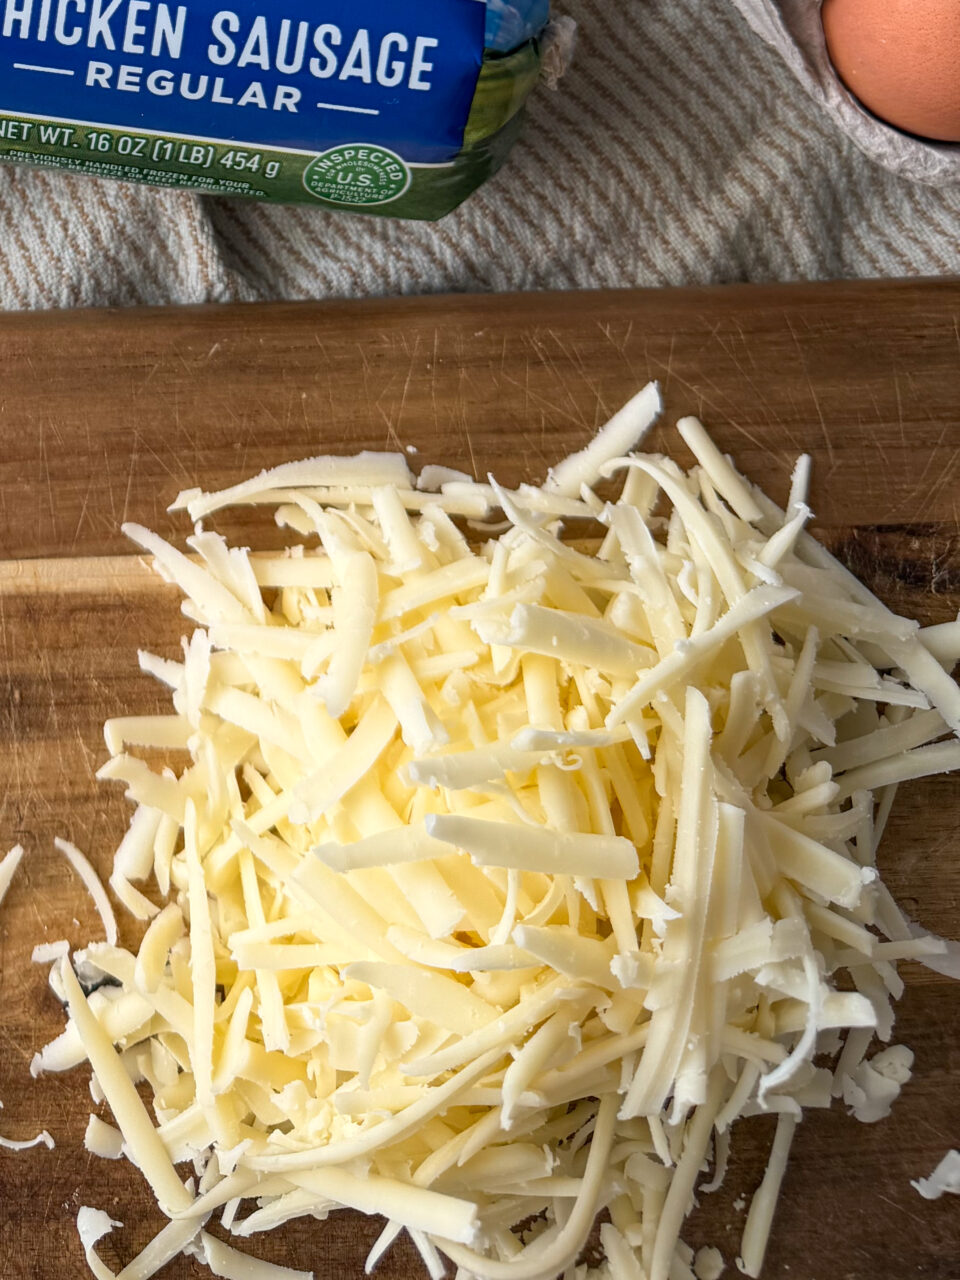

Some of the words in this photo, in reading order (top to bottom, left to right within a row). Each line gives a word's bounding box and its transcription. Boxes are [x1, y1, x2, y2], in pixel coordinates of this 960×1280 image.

[207, 10, 438, 91] SAUSAGE
[85, 60, 302, 113] REGULAR
[40, 125, 79, 148] WT.
[87, 132, 110, 152] 16
[117, 136, 146, 157] OZ
[152, 140, 173, 161] (1
[178, 144, 215, 168] LB)
[220, 150, 261, 172] 454
[265, 161, 280, 179] g
[313, 149, 403, 181] INSPECTED
[9, 150, 81, 165] PREVIOUSLY
[85, 160, 139, 173] HANDLED
[143, 169, 189, 180] FROZEN
[192, 175, 215, 184] FOR
[219, 179, 250, 189] YOUR
[147, 175, 177, 184] KEEP
[336, 171, 375, 187] U.S.
[311, 181, 379, 194] DEPARTMENT
[315, 187, 385, 200] AGRICULTURE
